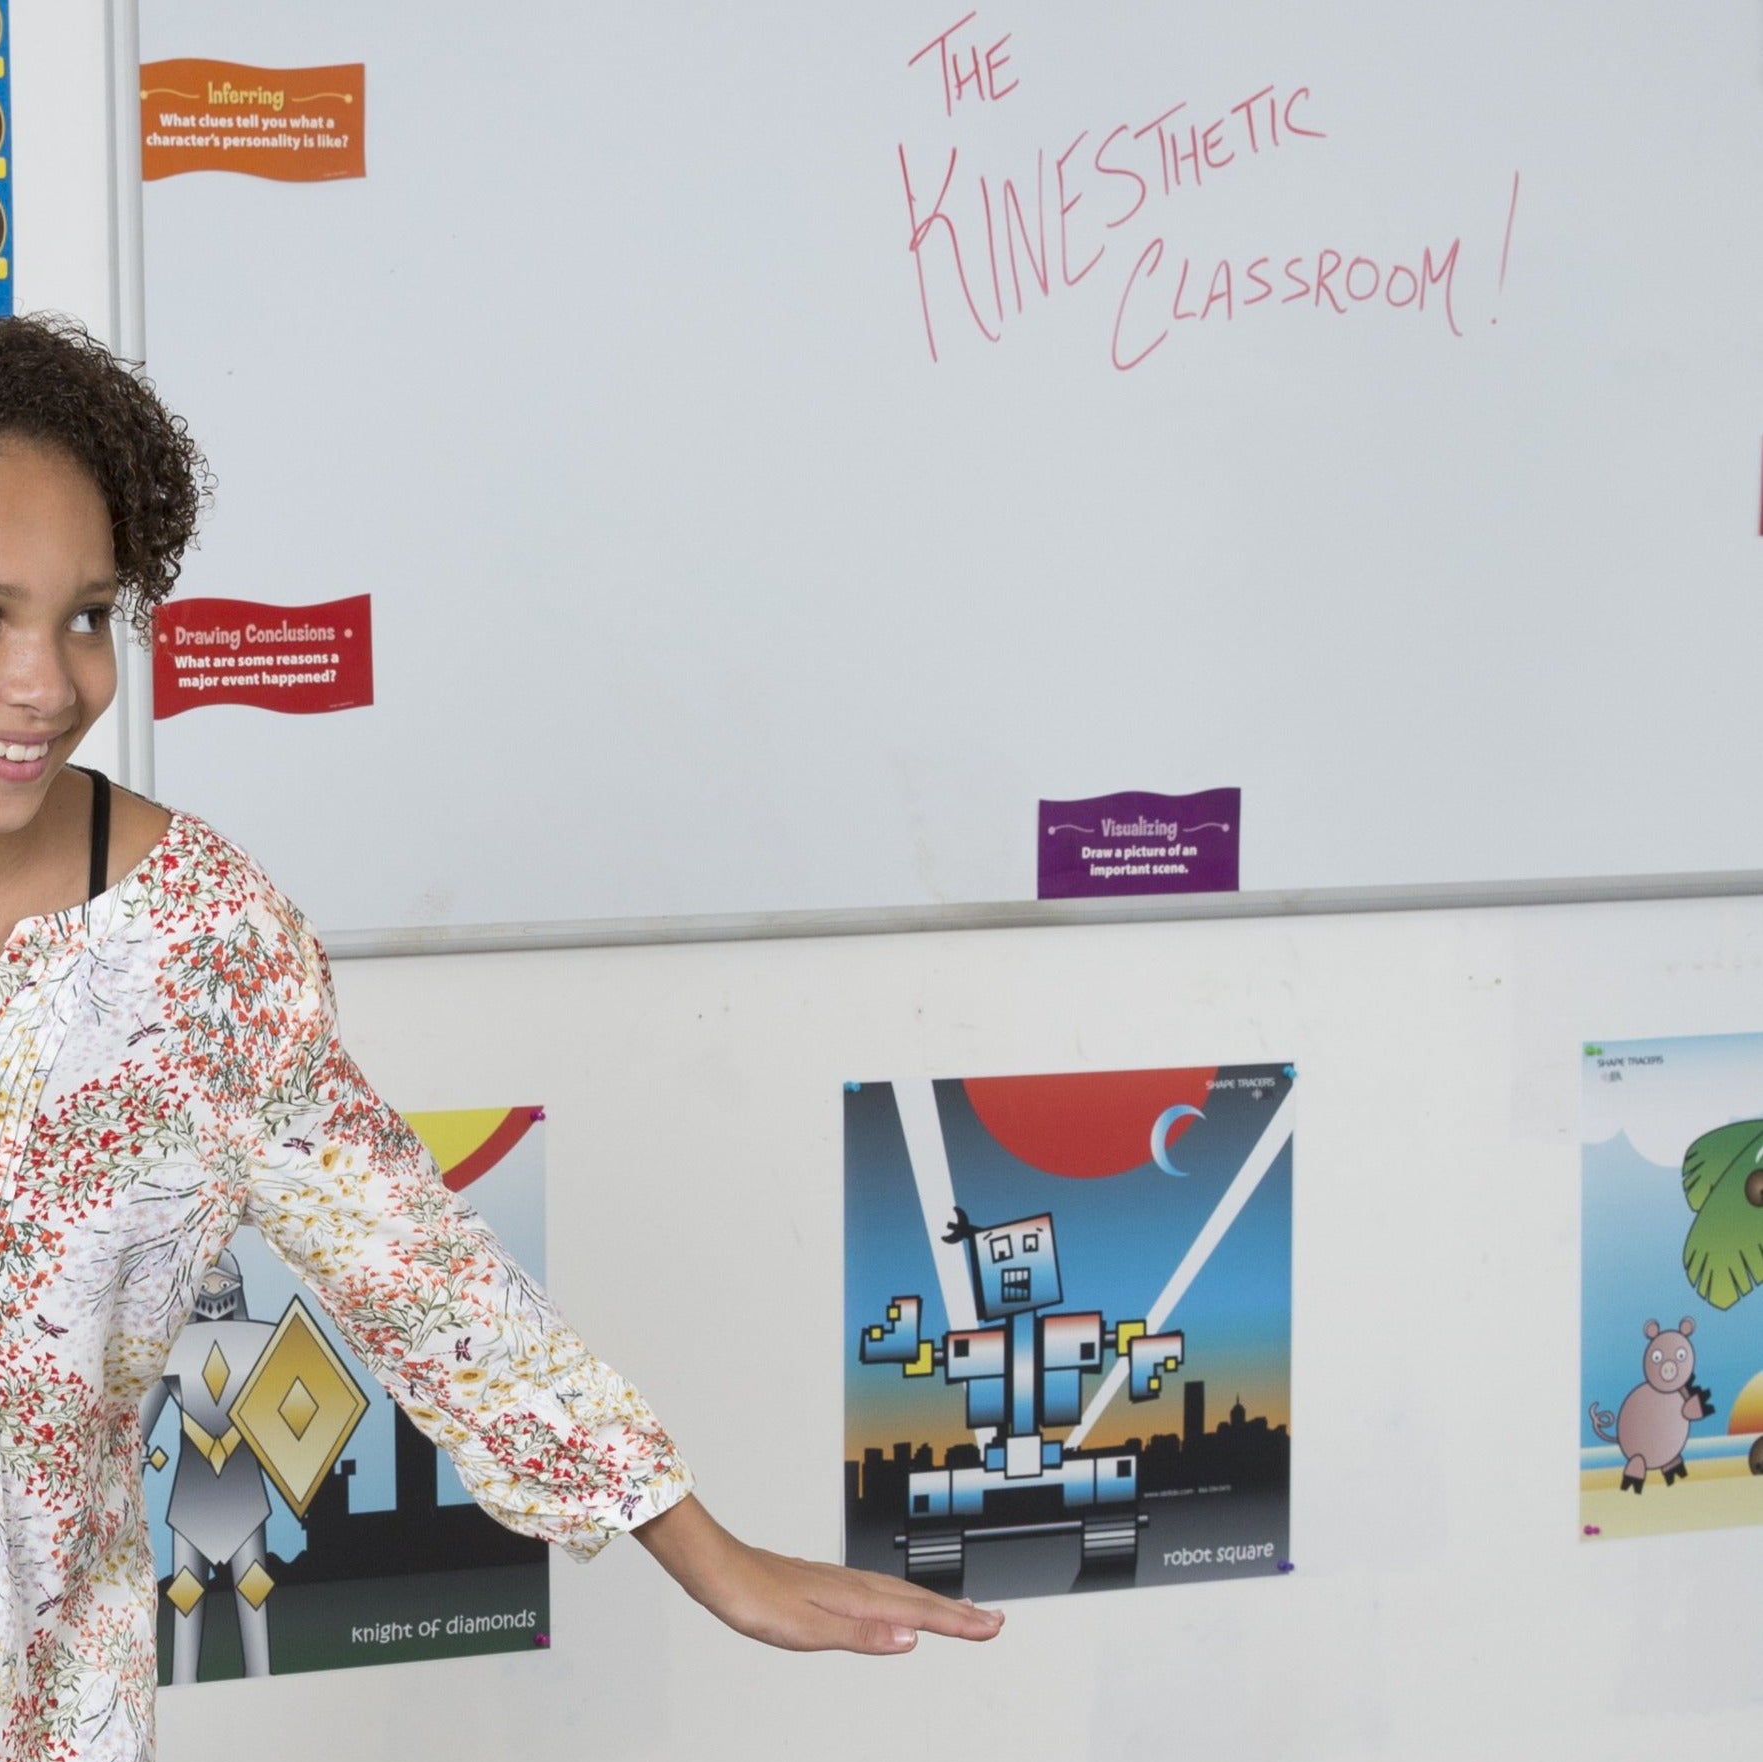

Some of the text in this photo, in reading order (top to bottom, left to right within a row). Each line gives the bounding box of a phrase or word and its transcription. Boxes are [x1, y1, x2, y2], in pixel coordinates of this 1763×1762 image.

[909, 11, 1019, 116] THE
[208, 82, 284, 111] Inferring
[160, 114, 334, 130] What clues tell you what a
[223, 134, 300, 150] personality
[304, 134, 314, 147] is
[317, 135, 349, 148] like?
[898, 87, 1326, 363] KINESTHETIC
[176, 620, 335, 650] Drawing Conclusions
[175, 654, 339, 668] What are some reasons a
[179, 670, 336, 690] major event happened?
[1102, 816, 1177, 841] Visualizing
[1082, 844, 1197, 860] Draw a picture of an
[1091, 864, 1189, 878] important scene.
[1164, 1543, 1273, 1565] robot square
[352, 1610, 536, 1643] knight of diamonds
